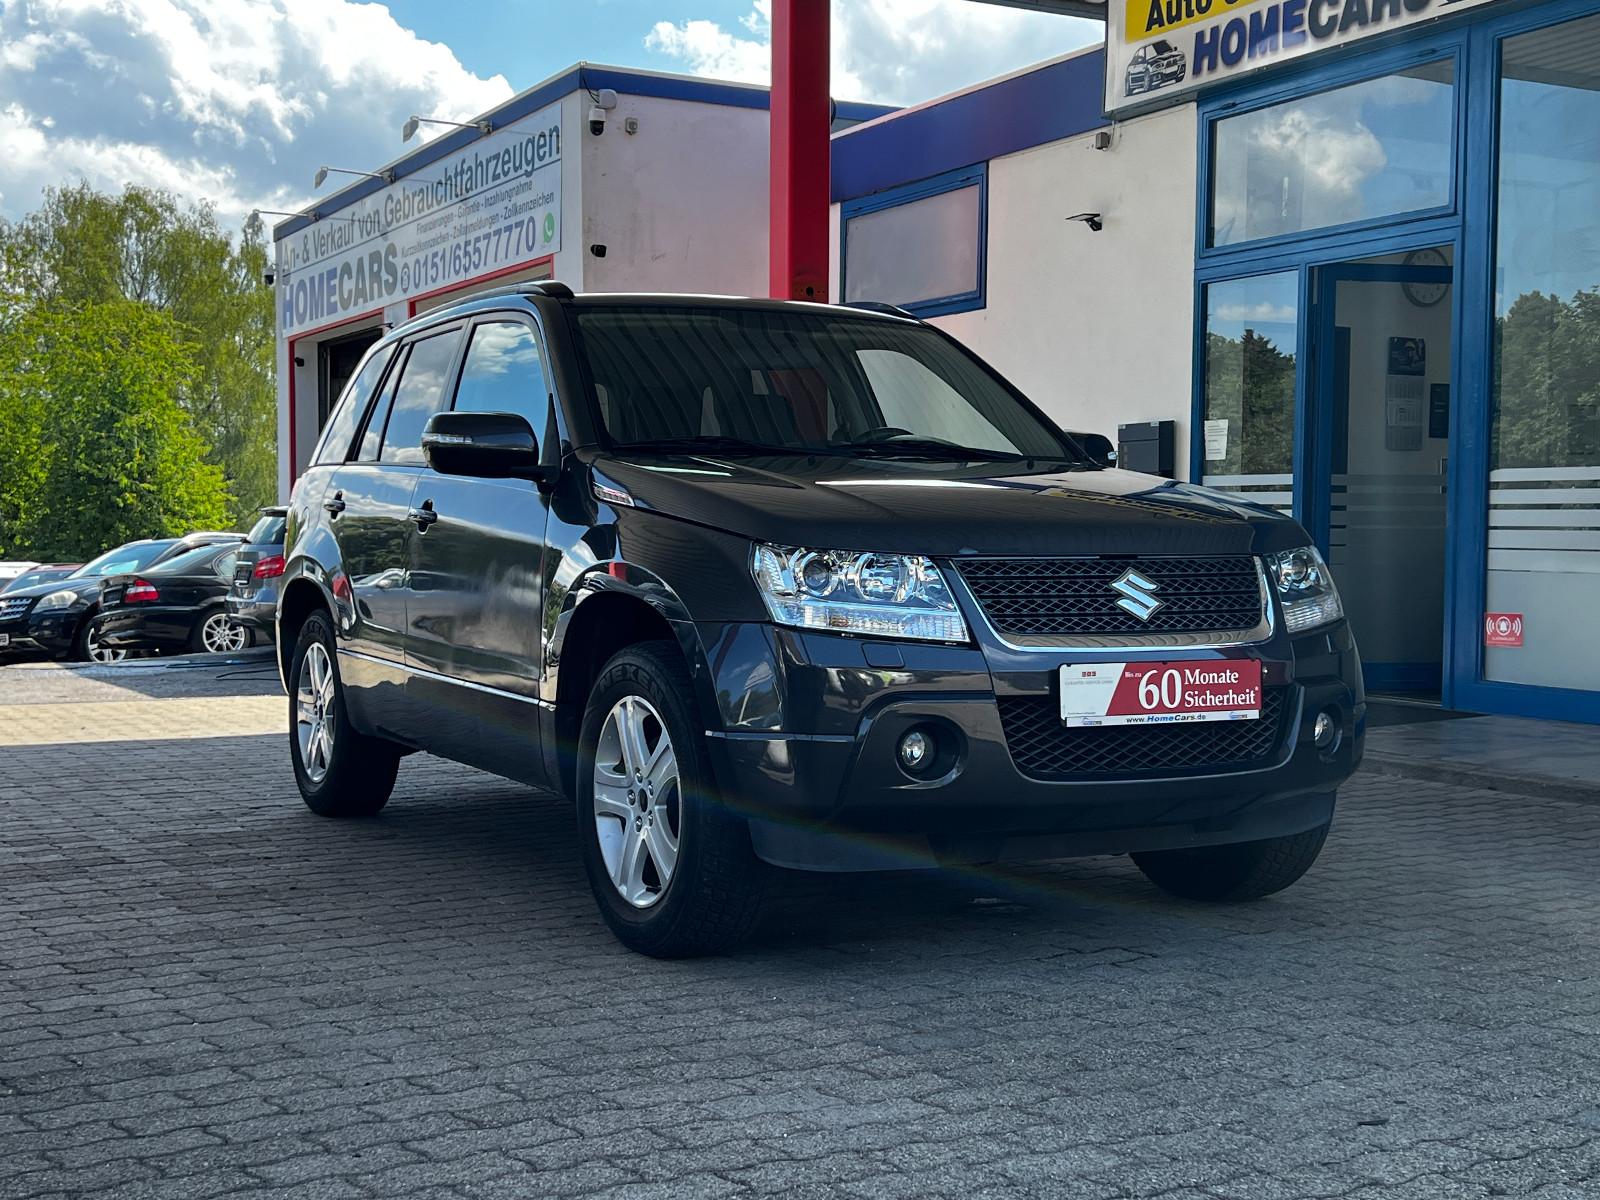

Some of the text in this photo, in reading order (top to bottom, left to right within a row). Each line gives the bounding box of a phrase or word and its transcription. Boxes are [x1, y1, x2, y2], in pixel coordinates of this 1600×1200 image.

[1145, 0, 1212, 32] Auto
[1192, 0, 1431, 76] HOMECA
[302, 234, 310, 263] &
[312, 211, 356, 259] Verkauf
[358, 208, 381, 239] von
[384, 124, 560, 228] Gebrauchtfahrzeugen
[504, 191, 555, 220] Zollkennzeichen
[282, 216, 536, 330] HOMECARS 0151/65577770
[1138, 669, 1182, 709] 60
[1184, 668, 1239, 685] Monate
